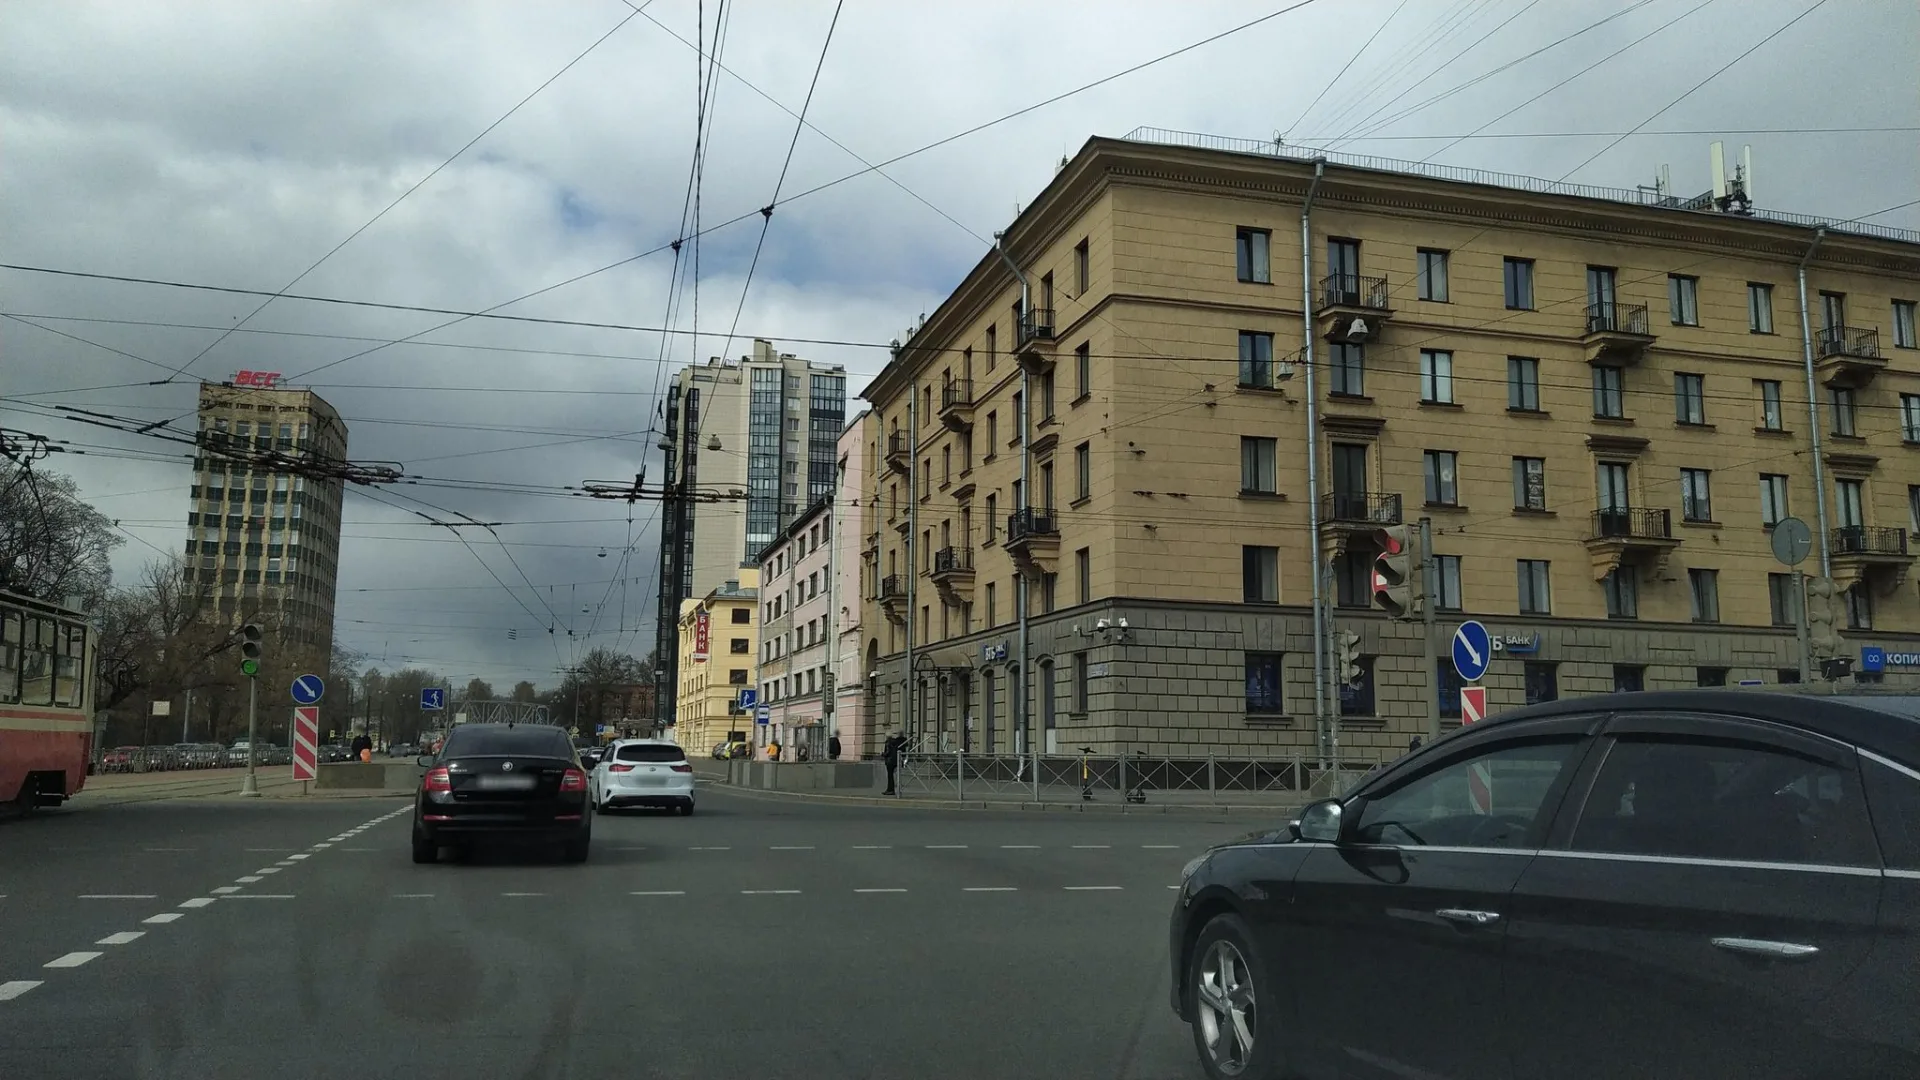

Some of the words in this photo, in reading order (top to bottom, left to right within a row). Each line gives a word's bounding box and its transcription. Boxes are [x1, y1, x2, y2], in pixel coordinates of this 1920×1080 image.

[698, 616, 706, 650] БАНК
[1506, 635, 1531, 645] БАНК
[1886, 653, 1920, 665] КОПИ
